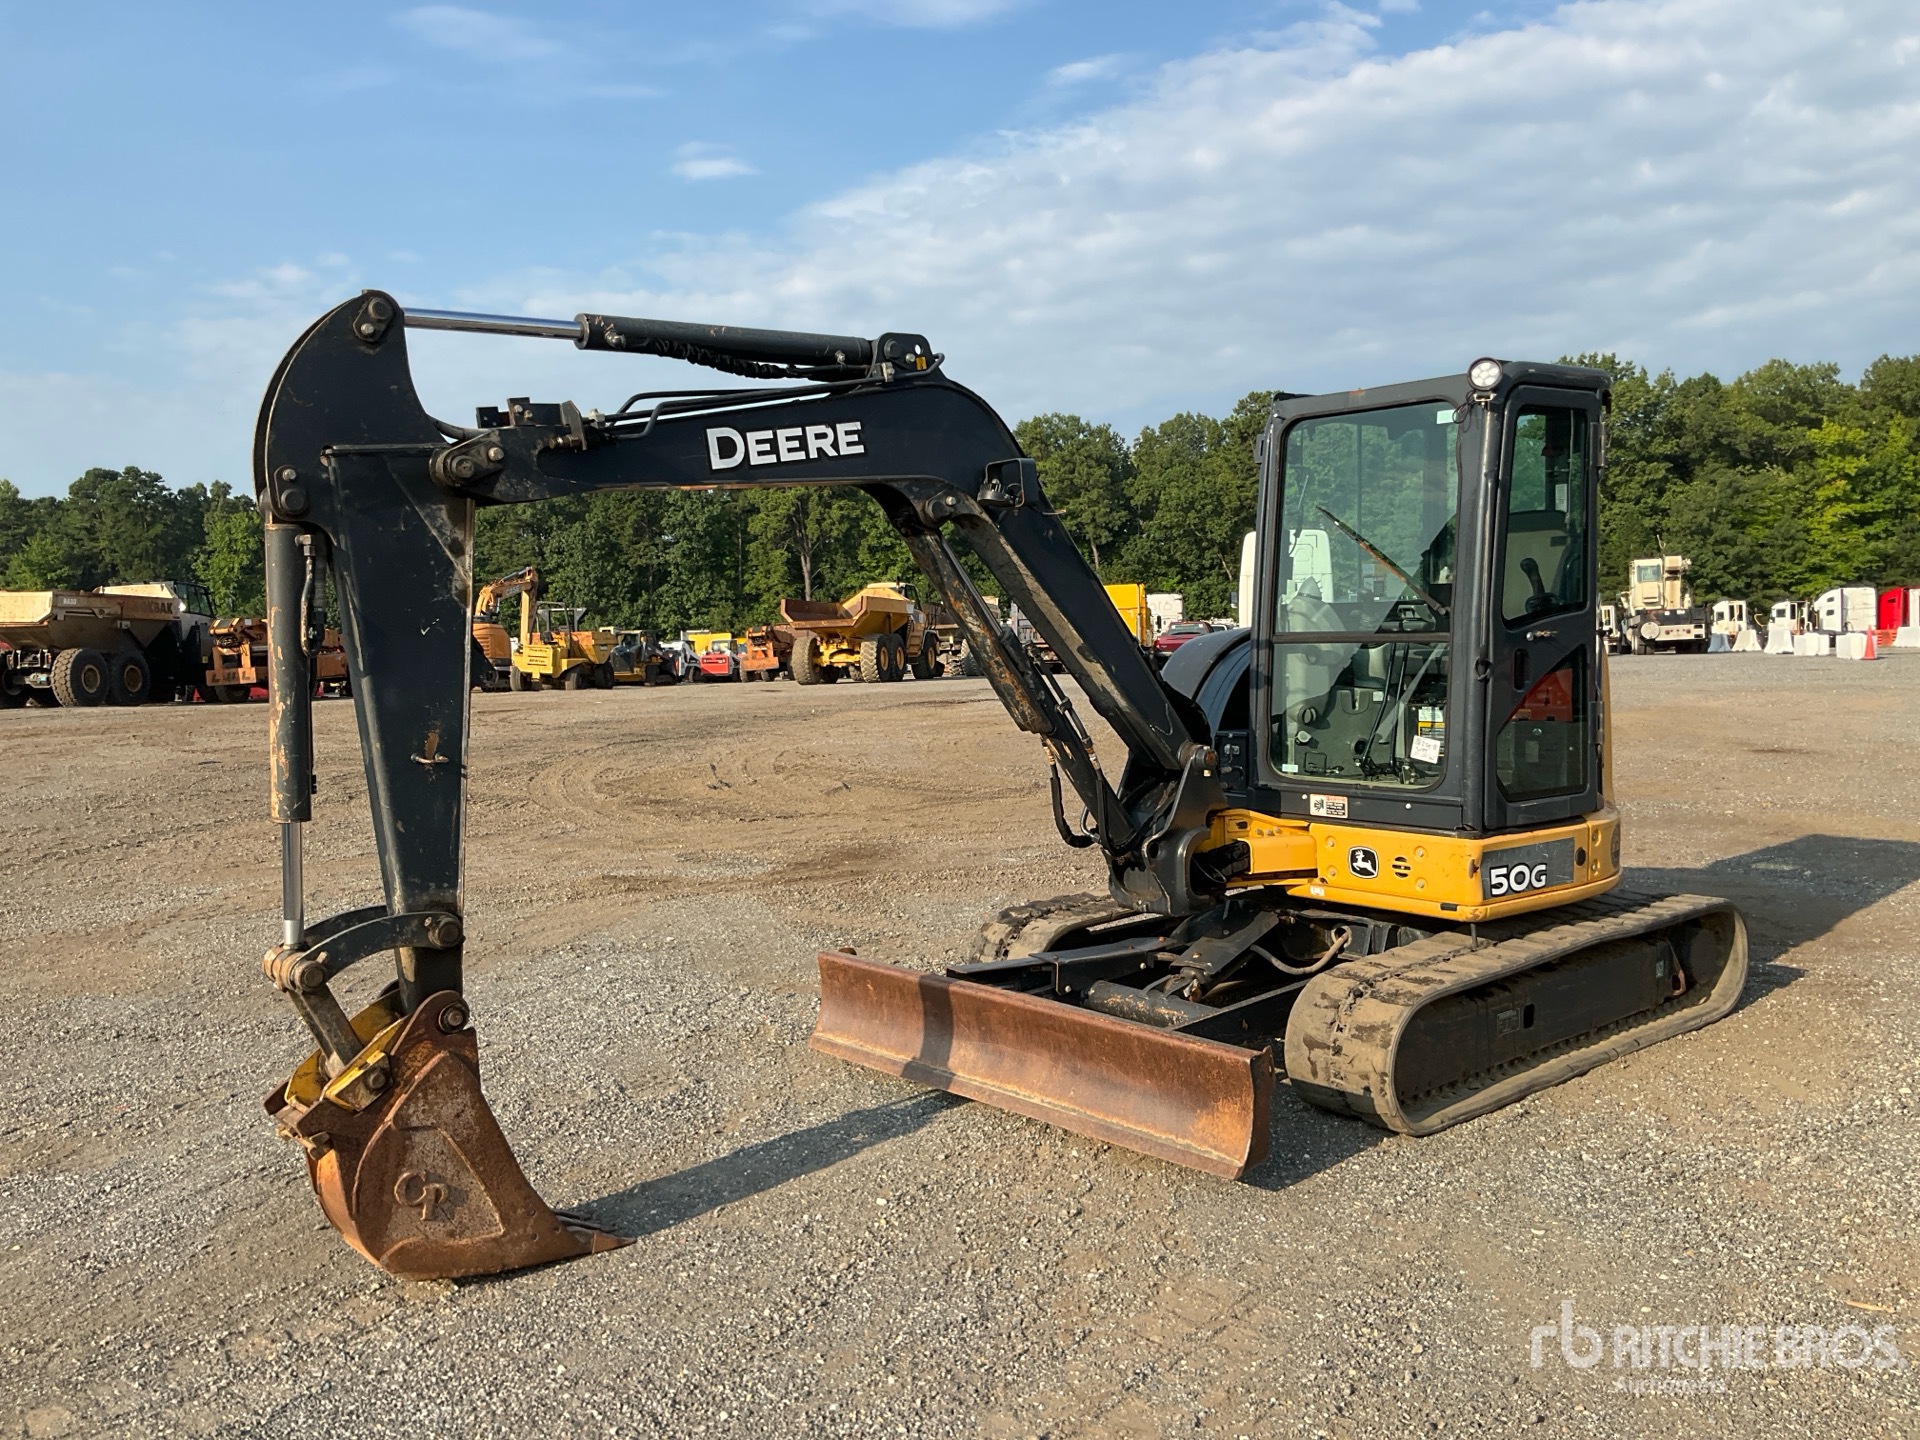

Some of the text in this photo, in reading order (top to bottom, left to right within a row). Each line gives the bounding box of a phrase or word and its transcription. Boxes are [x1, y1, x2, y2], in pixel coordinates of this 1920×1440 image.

[706, 421, 865, 470] DEERE
[505, 584, 521, 596] CASE
[1490, 863, 1547, 896] 50G
